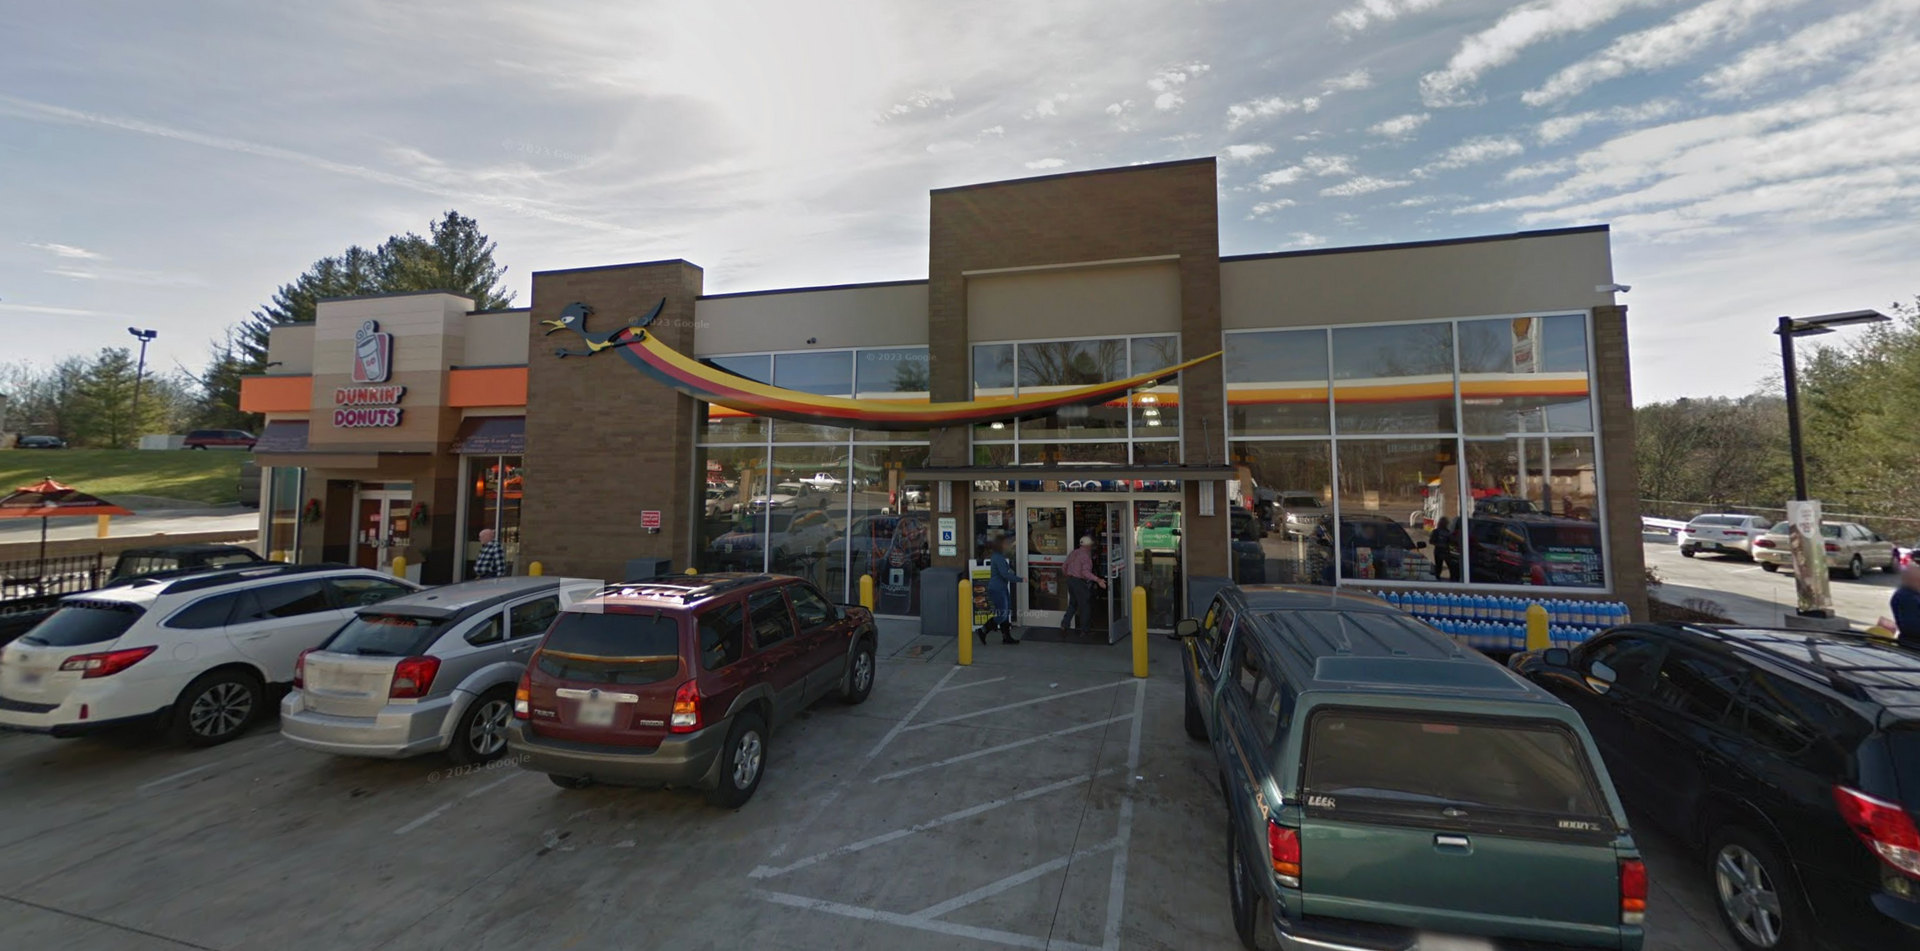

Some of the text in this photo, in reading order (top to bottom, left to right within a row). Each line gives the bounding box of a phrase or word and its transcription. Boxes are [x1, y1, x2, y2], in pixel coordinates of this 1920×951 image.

[335, 386, 403, 405] DUNKIN'
[333, 408, 401, 427] DONUTS
[1308, 795, 1336, 809] LEER
